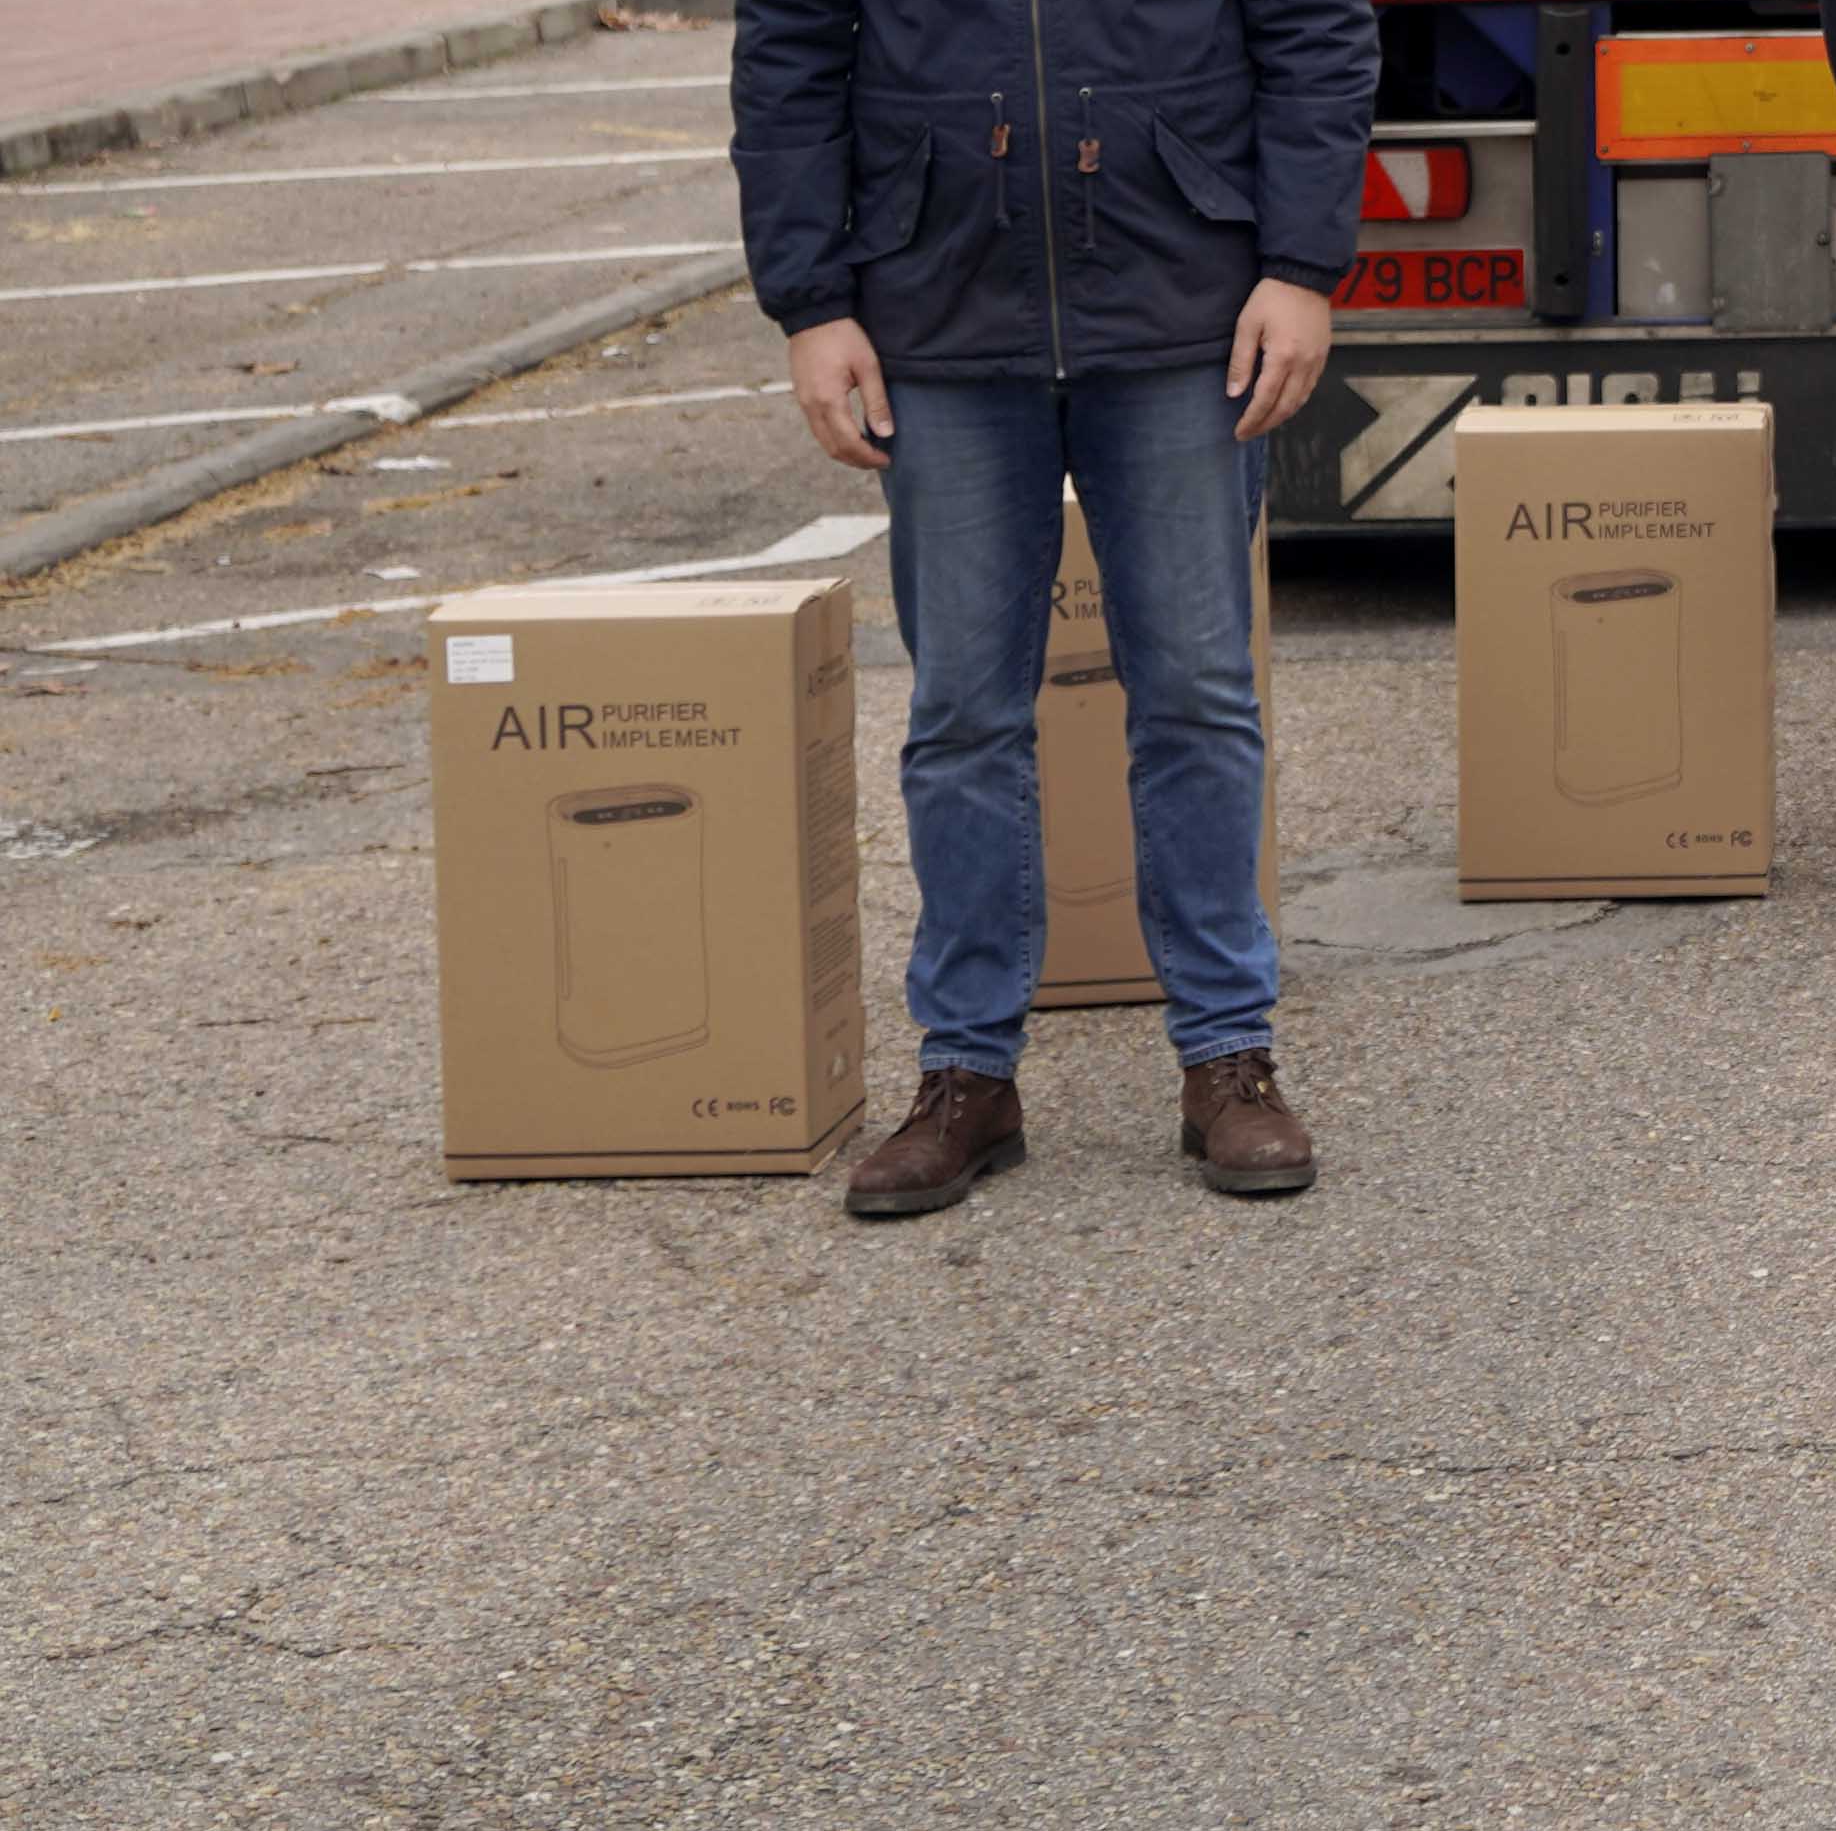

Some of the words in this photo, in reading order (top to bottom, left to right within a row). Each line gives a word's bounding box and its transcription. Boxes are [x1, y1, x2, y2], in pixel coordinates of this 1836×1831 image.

[1341, 257, 1402, 302] 79
[1425, 256, 1517, 302] BCP
[1505, 502, 1595, 540] AIR
[1598, 500, 1687, 518] PURIFIER
[1595, 522, 1716, 539] IMPLEMENT
[491, 704, 597, 750] AIR
[601, 702, 708, 723] PURIFIER
[602, 728, 741, 749] IMPLEMENT
